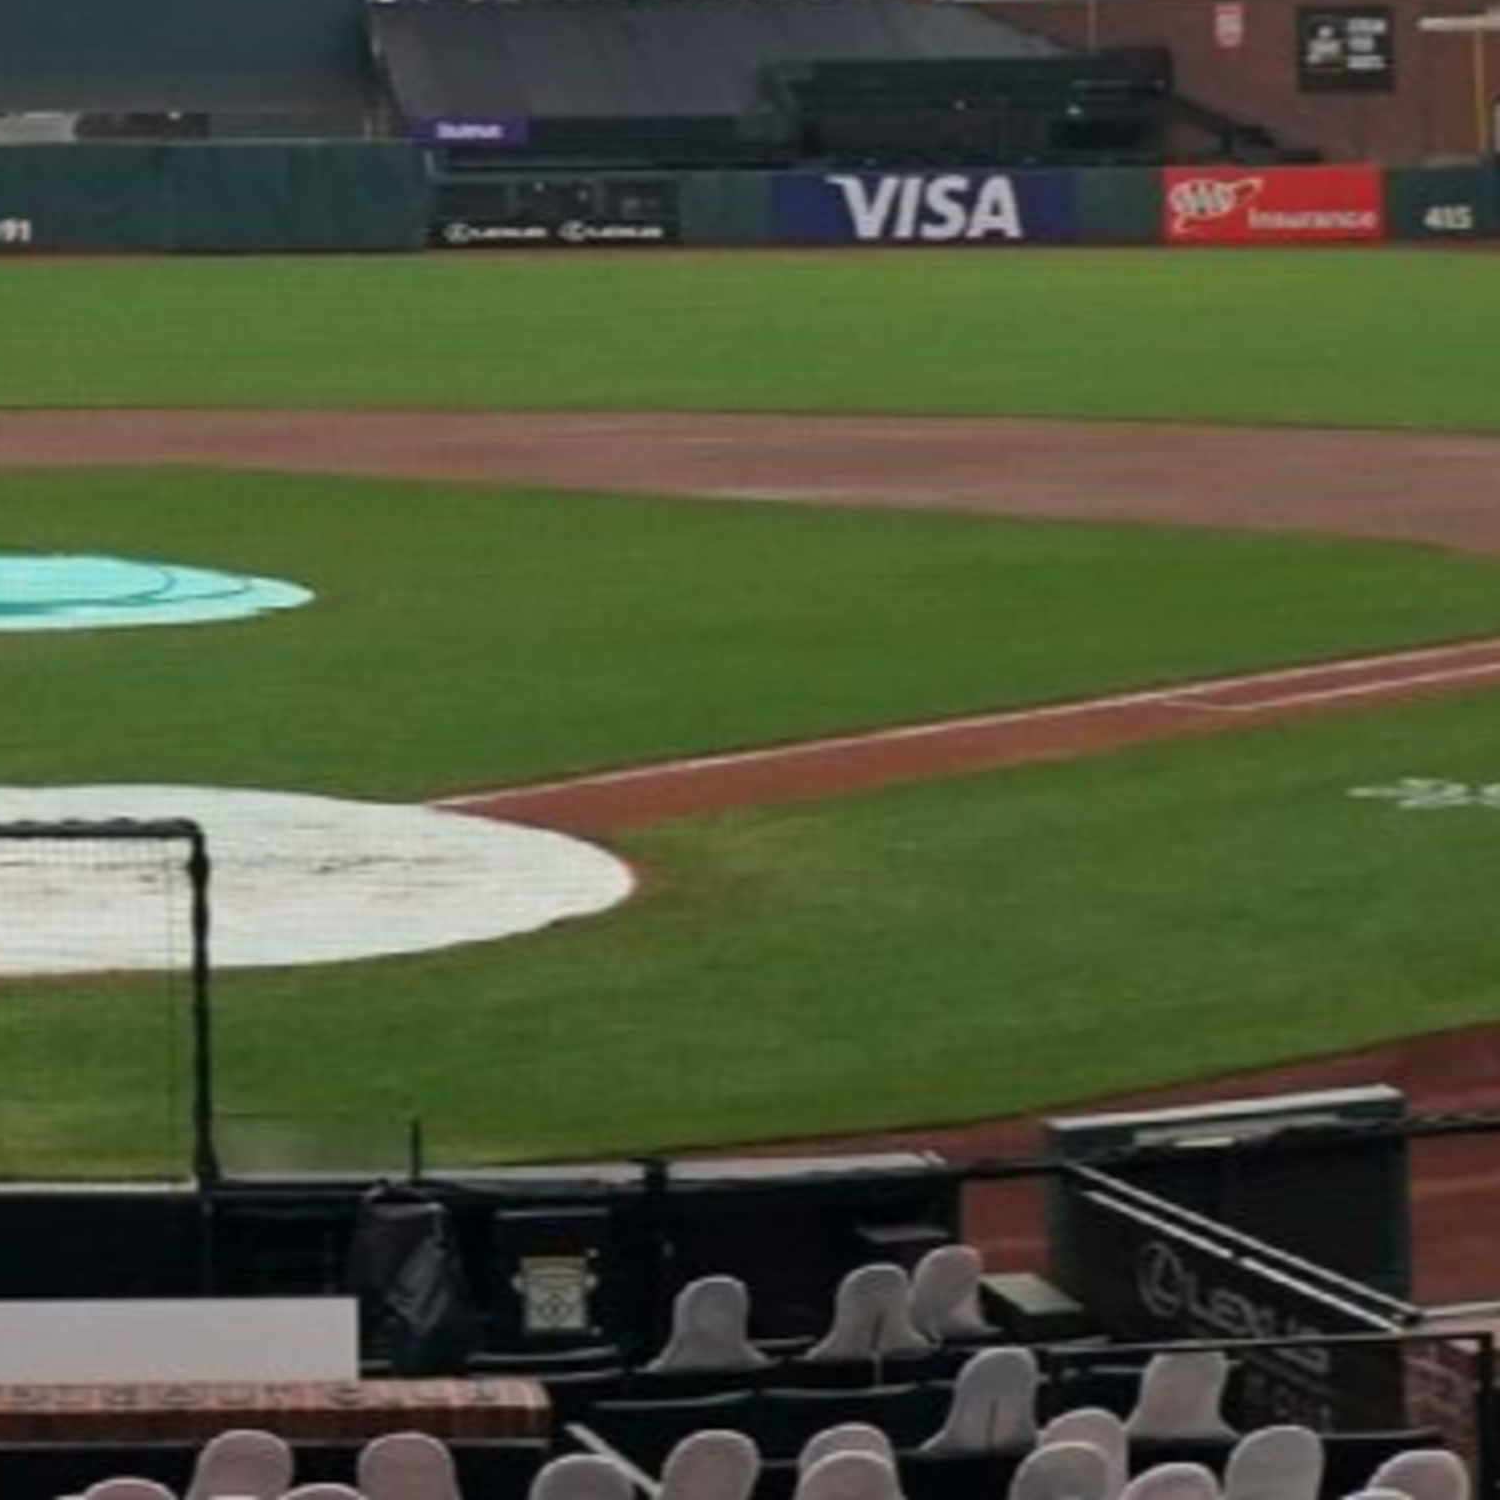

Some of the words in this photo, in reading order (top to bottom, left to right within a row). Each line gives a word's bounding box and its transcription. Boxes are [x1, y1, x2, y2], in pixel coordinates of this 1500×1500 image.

[826, 174, 1022, 239] VISA
[1247, 206, 1378, 230] Insurance
[1423, 206, 1473, 230] 415
